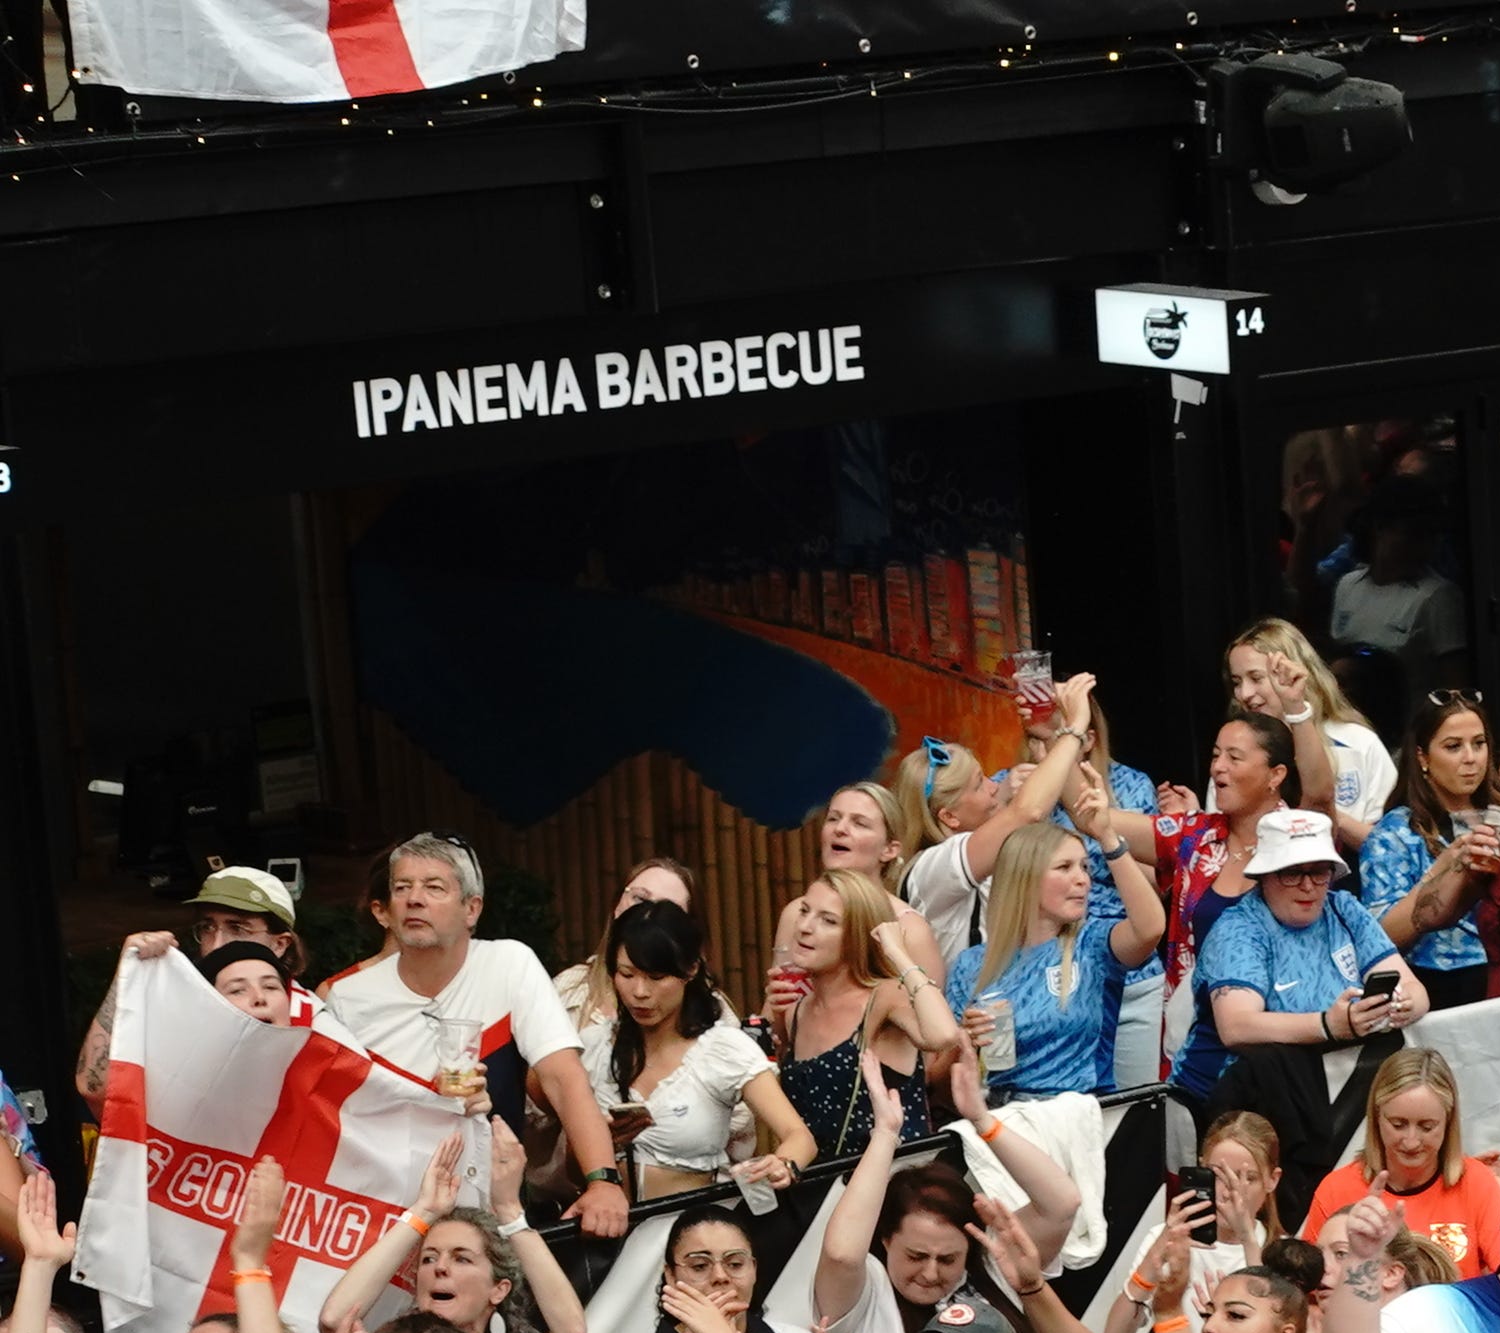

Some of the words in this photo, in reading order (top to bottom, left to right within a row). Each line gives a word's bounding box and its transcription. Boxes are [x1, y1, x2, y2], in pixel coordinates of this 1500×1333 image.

[1236, 307, 1265, 337] 14
[354, 358, 586, 438] IPANEMA
[595, 325, 864, 412] BARBECUE
